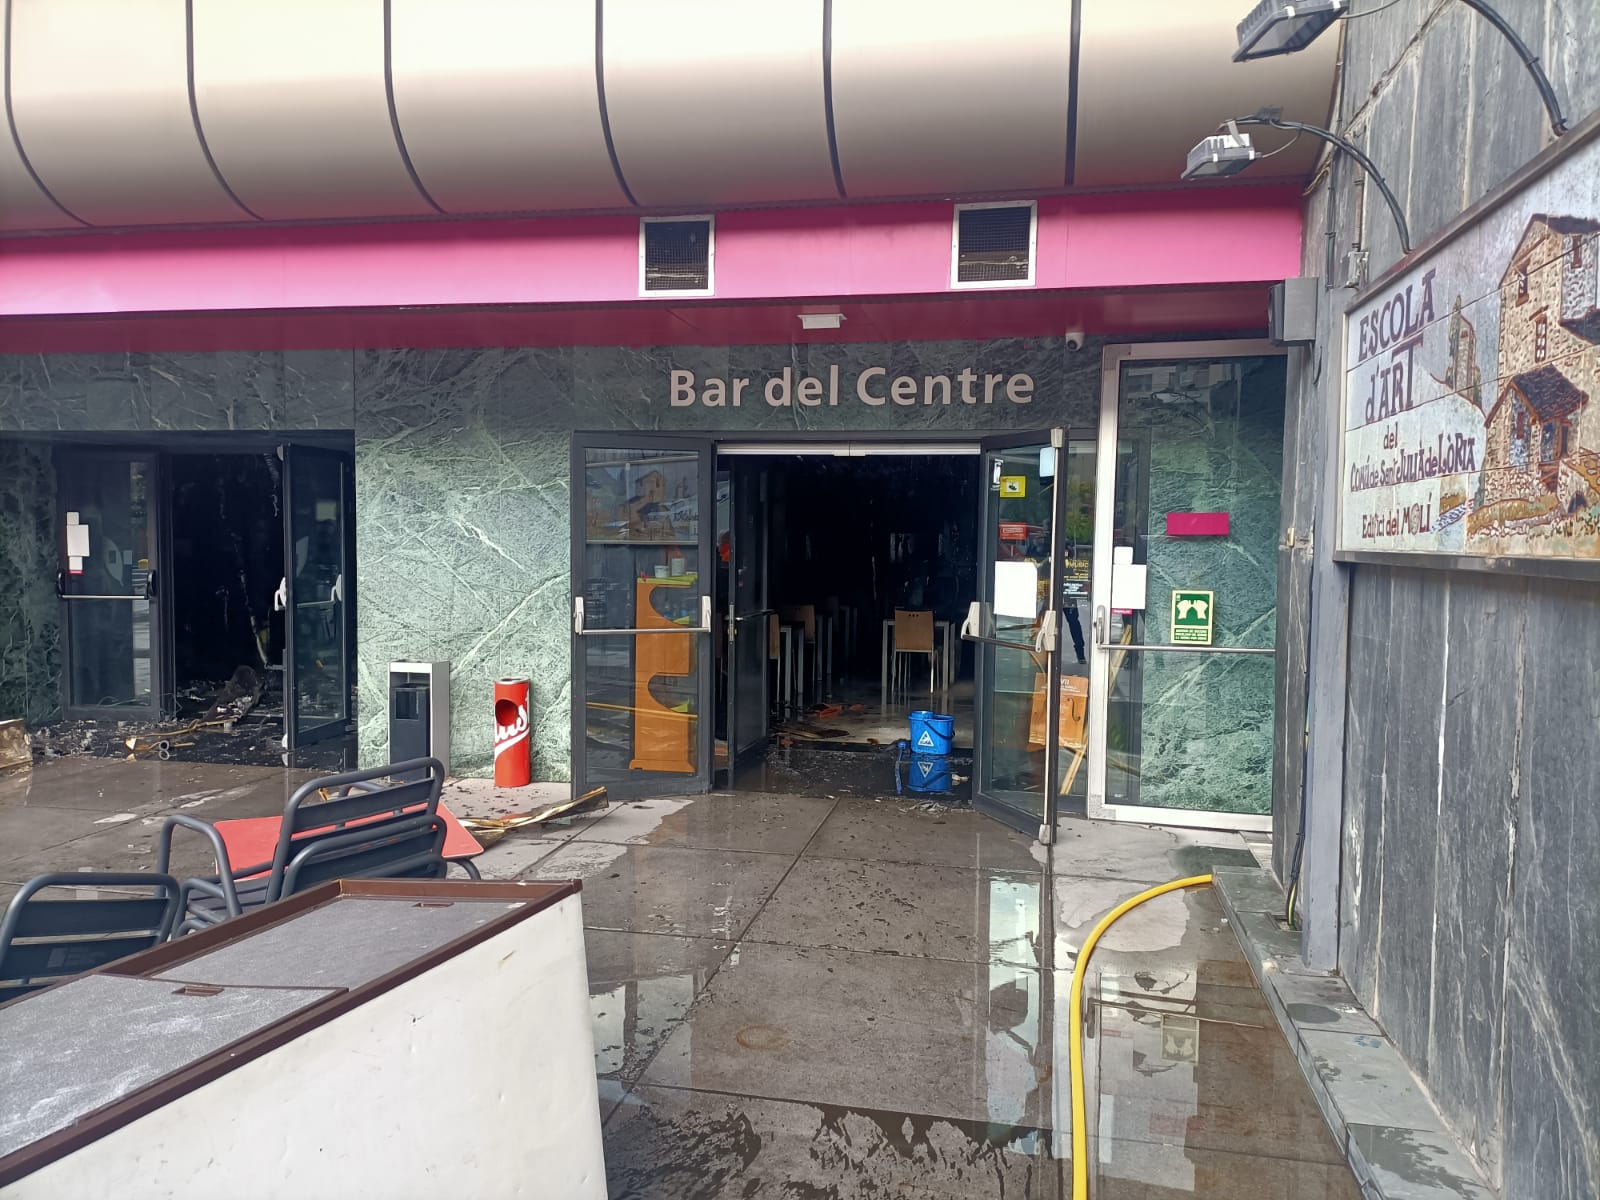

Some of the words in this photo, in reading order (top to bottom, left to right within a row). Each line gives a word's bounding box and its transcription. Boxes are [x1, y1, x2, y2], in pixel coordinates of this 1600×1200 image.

[1358, 268, 1436, 362] ESCOLA
[669, 369, 749, 408] Bar
[764, 364, 839, 408] del
[856, 366, 1034, 407] Centre
[1365, 332, 1424, 424] d'ART
[1383, 421, 1398, 449] del
[1424, 446, 1438, 477] de
[1361, 511, 1385, 543] Edifici
[1386, 508, 1399, 536] del
[1400, 492, 1432, 536] MOLÍ
